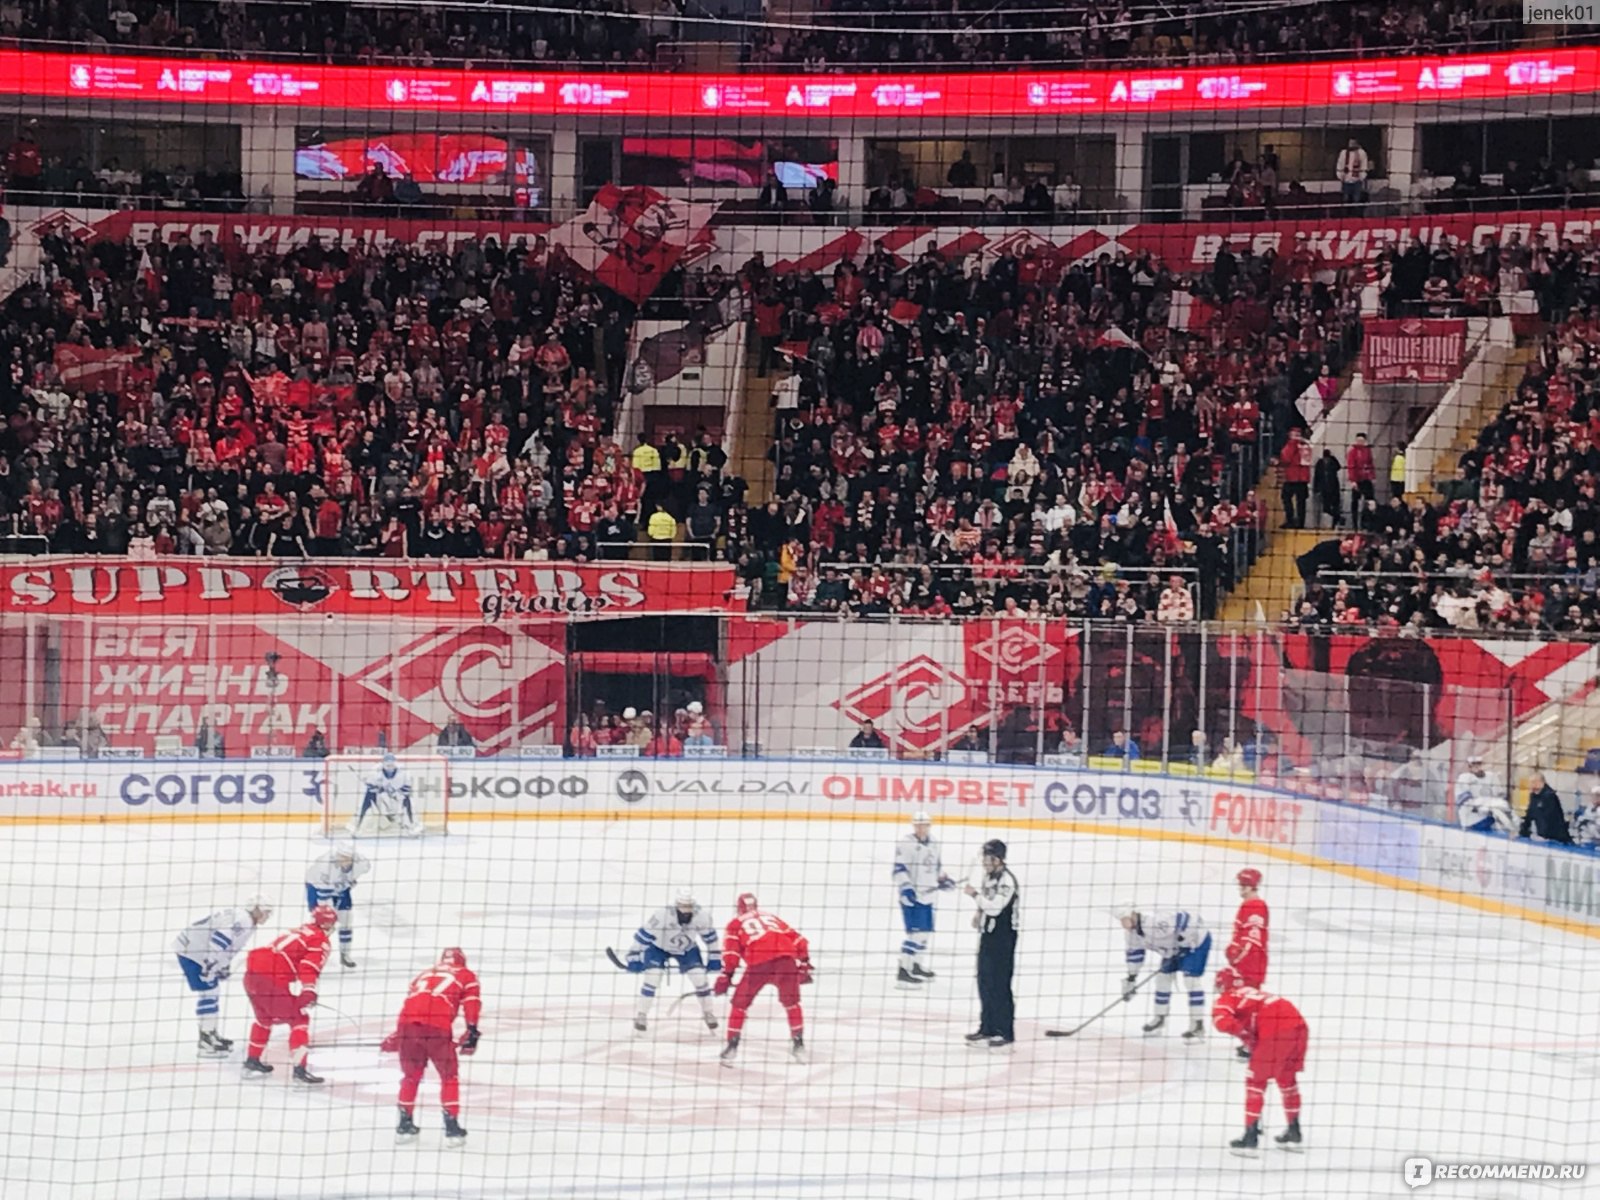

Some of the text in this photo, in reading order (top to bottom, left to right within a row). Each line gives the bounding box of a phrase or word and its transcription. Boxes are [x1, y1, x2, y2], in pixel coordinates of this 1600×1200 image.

[94, 626, 199, 657] ВСЯ
[94, 664, 289, 696] ЖИЗНЬ
[99, 703, 332, 735] СПАРТАК
[411, 775, 589, 799] НЬКОФФ
[655, 779, 810, 796] VALDAI
[822, 776, 1034, 808] OLIMPBET
[1210, 792, 1303, 844] FONBET
